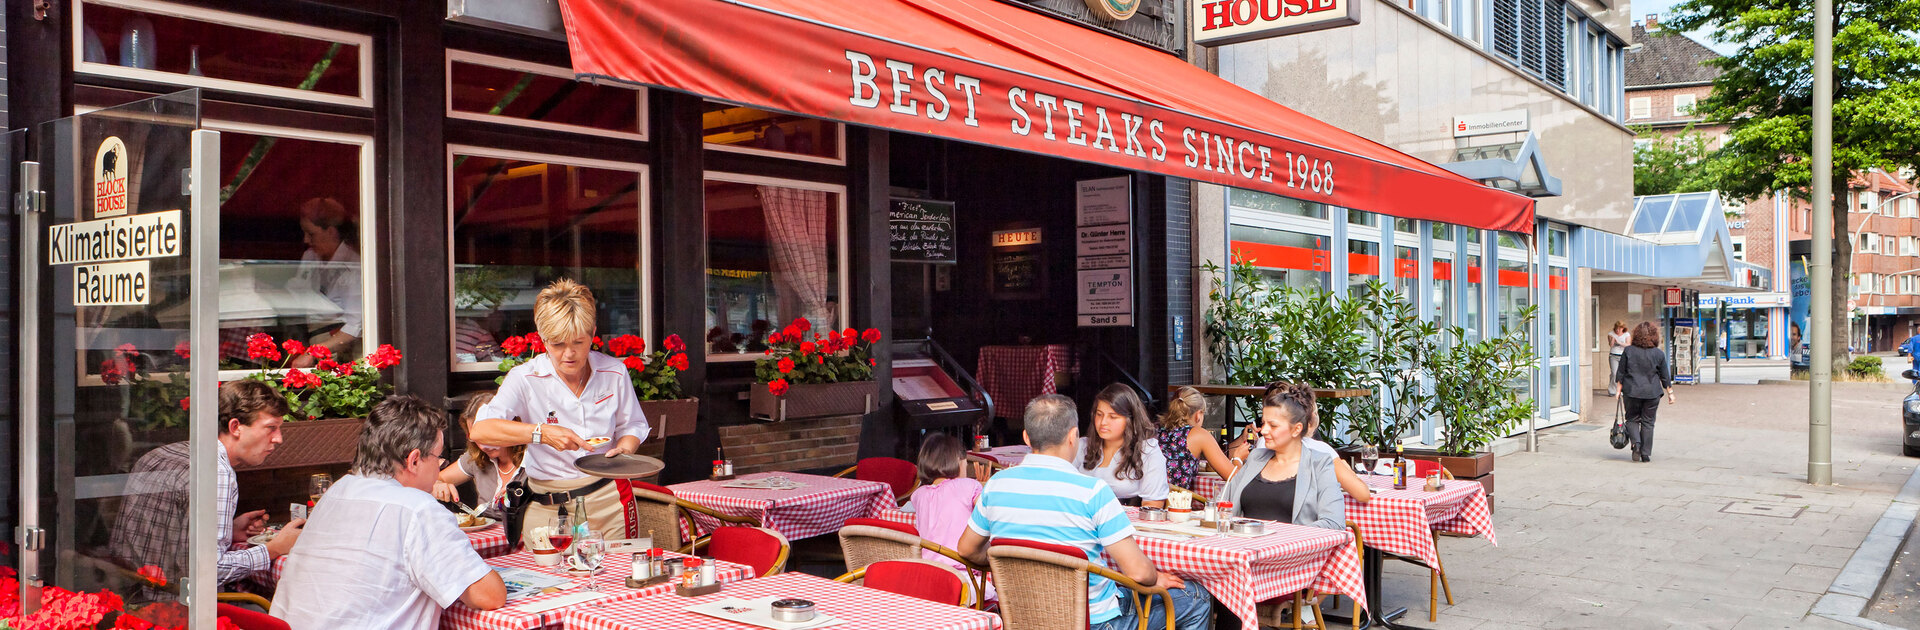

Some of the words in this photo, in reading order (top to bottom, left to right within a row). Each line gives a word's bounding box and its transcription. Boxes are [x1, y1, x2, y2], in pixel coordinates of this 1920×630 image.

[845, 49, 981, 128] BEST
[1008, 86, 1167, 163] STEAKS
[1182, 126, 1273, 184] SINCE
[1285, 152, 1334, 196] 1968
[1468, 120, 1523, 131] ImmobilienCenter
[97, 177, 126, 198] BLOCK
[97, 194, 126, 213] HOUSE
[52, 216, 176, 263] Klimatisierte
[998, 231, 1037, 243] HEUTE
[77, 266, 145, 303] Räume
[1667, 290, 1680, 304] Bild
[1725, 296, 1755, 305] Bank
[1090, 316, 1110, 324] Sand
